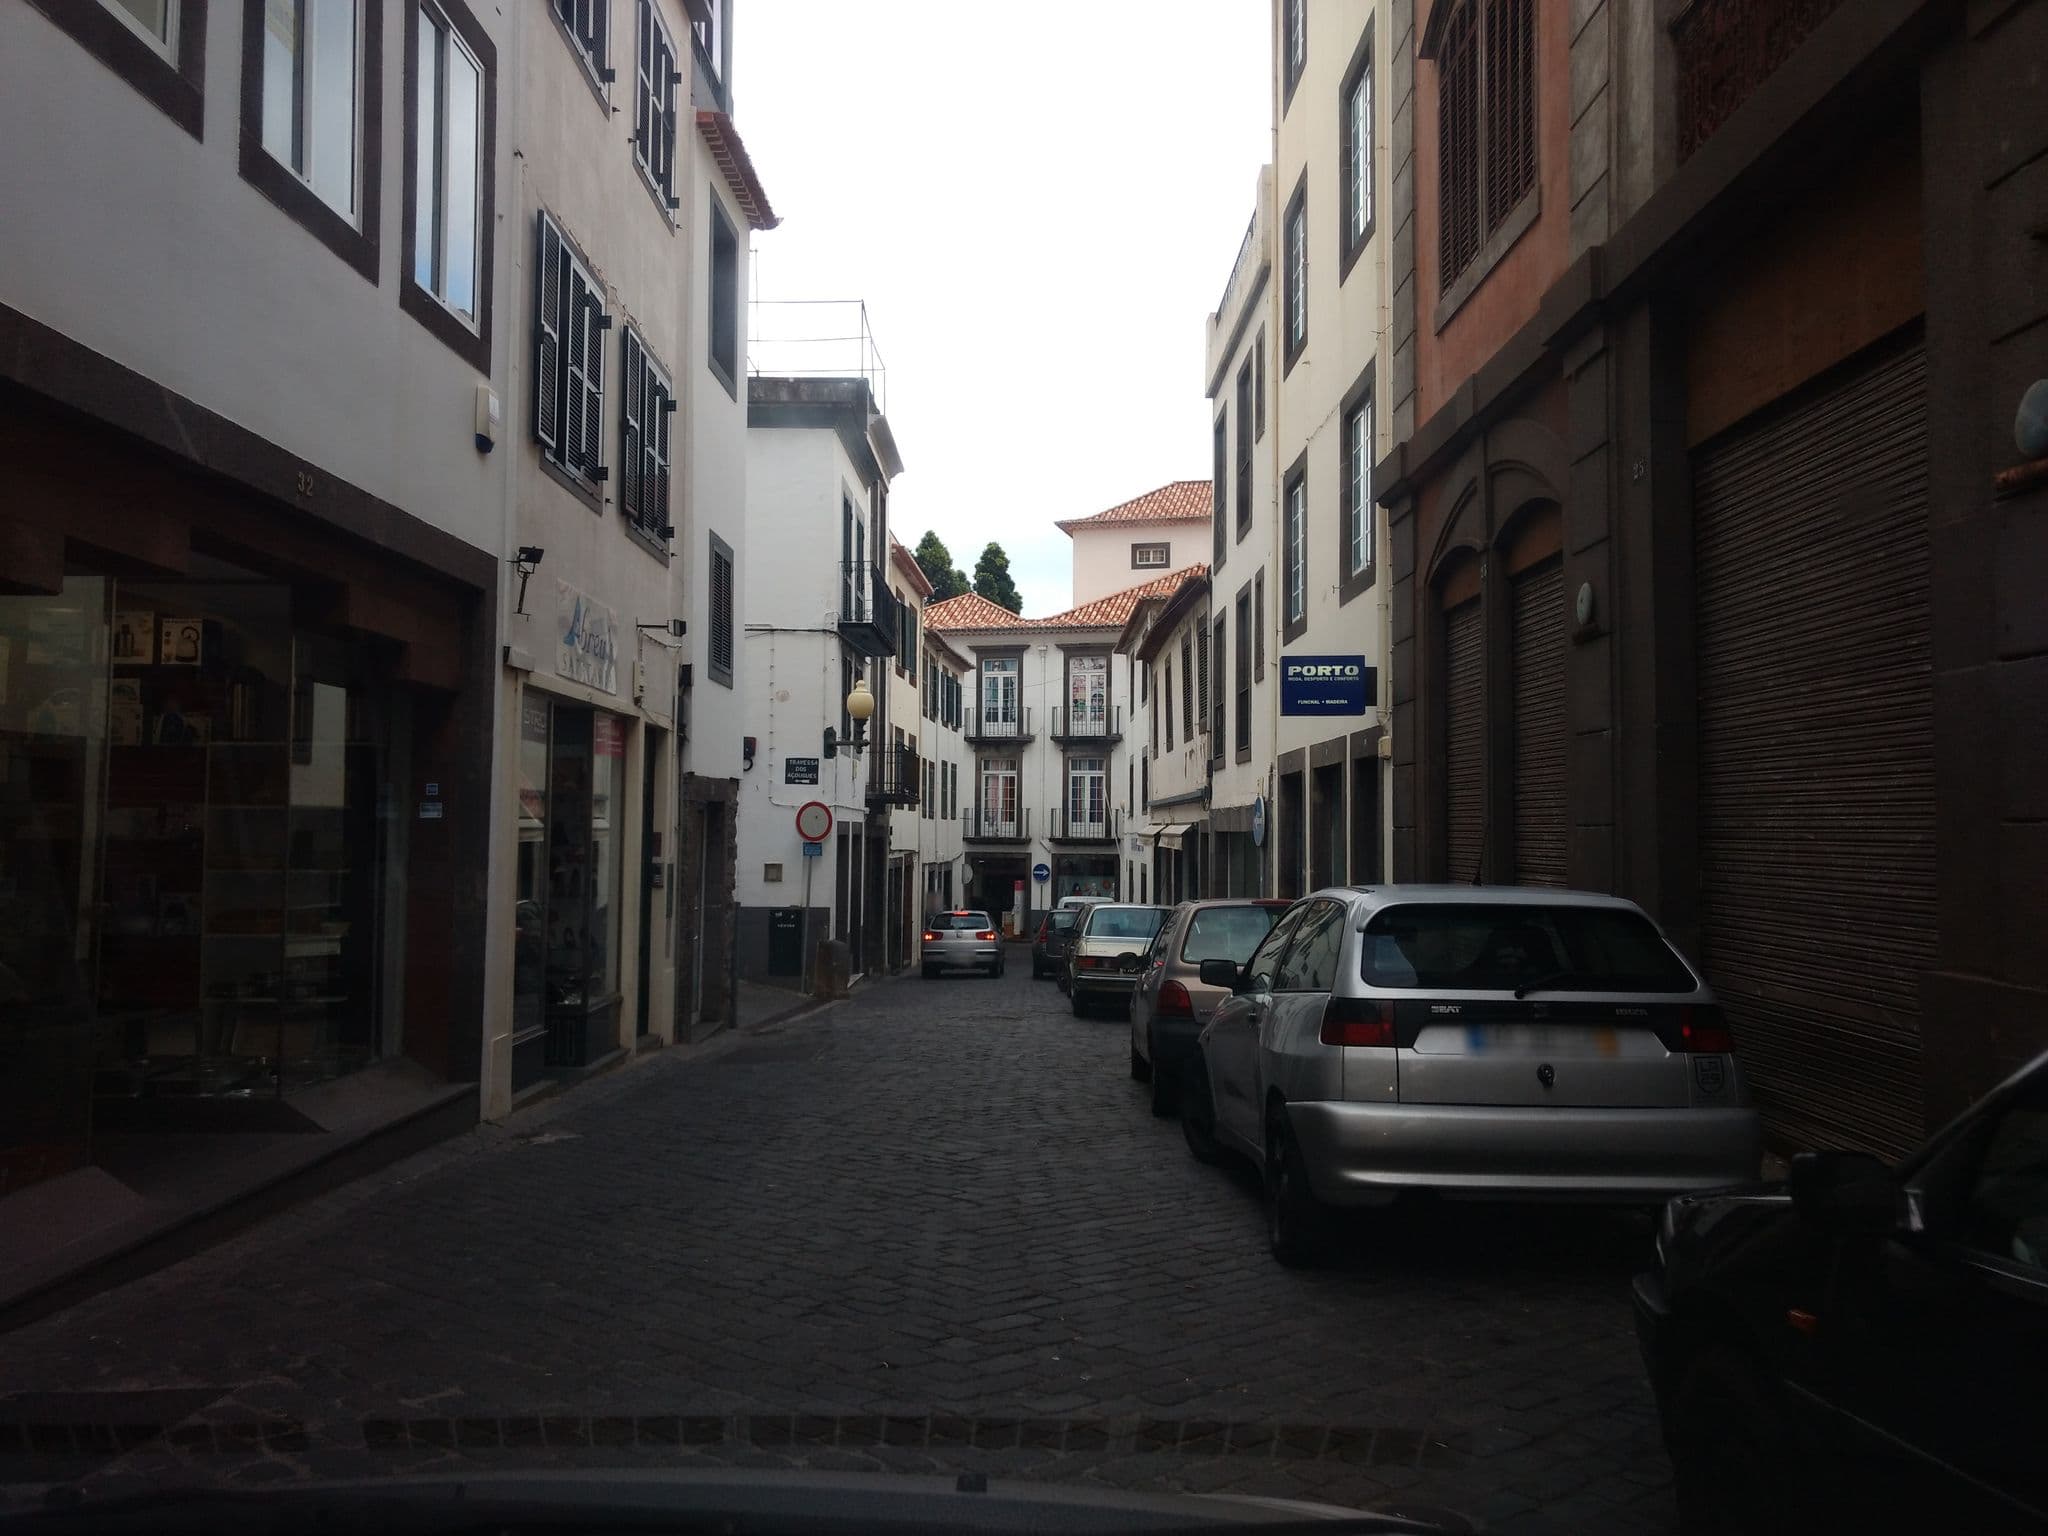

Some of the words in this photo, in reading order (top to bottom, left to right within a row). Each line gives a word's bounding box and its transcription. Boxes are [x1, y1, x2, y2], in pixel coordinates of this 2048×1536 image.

[297, 471, 313, 497] 32
[1287, 665, 1360, 676] PORTO
[1431, 1005, 1462, 1014] SEAT
